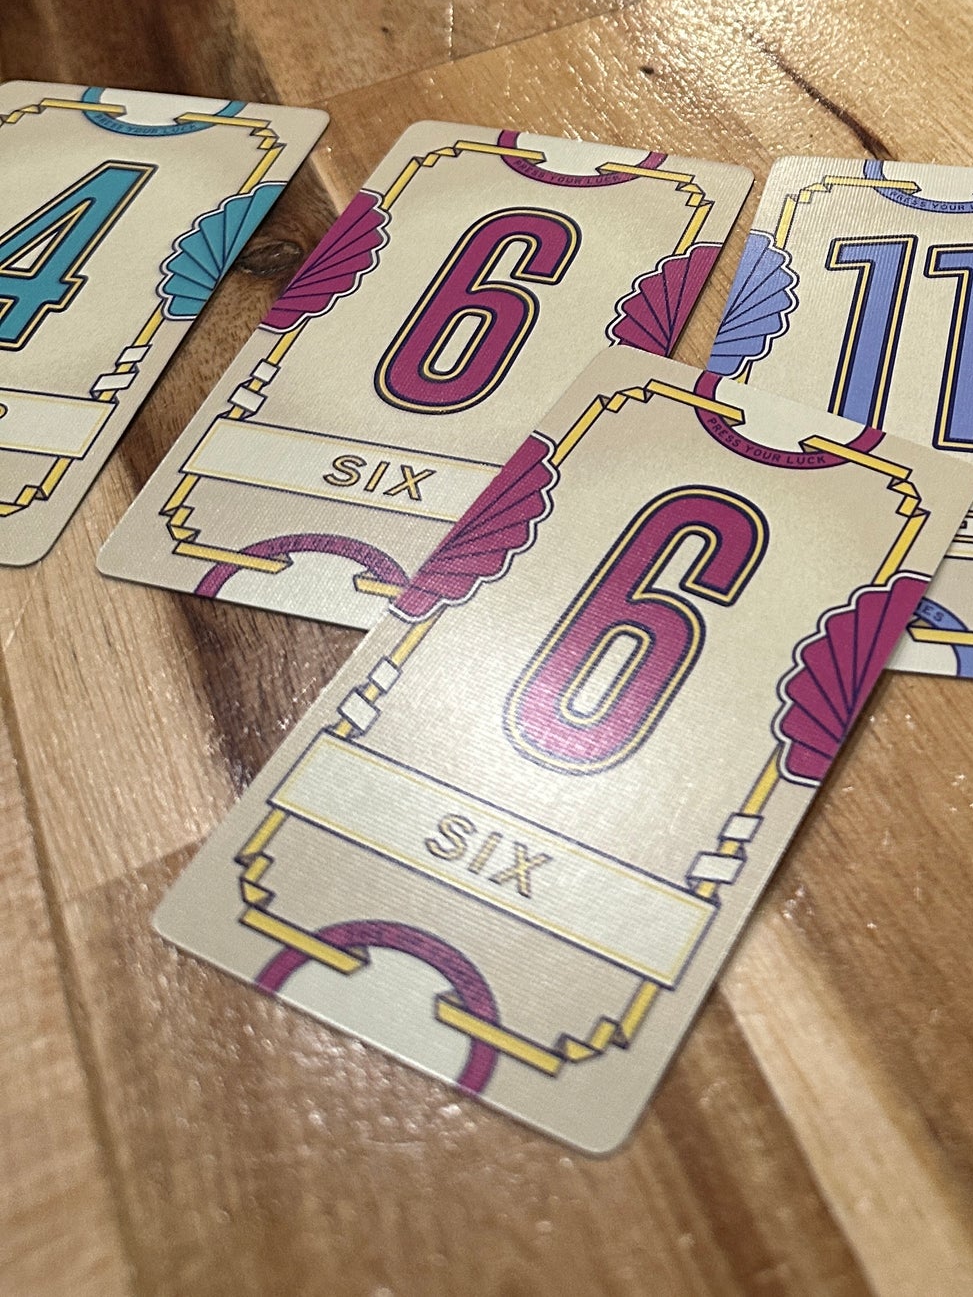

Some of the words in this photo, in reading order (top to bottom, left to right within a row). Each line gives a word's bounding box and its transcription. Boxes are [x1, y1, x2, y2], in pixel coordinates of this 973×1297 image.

[889, 190, 926, 208] PRESS
[931, 202, 966, 212] YOUR
[0, 159, 159, 351] 4
[373, 207, 582, 414] 6
[322, 454, 437, 501] SIX
[706, 417, 742, 448] PRESS
[745, 445, 782, 463] YOUR
[786, 455, 827, 465] LUCK
[503, 484, 769, 776] 6
[424, 813, 550, 900] SIX
